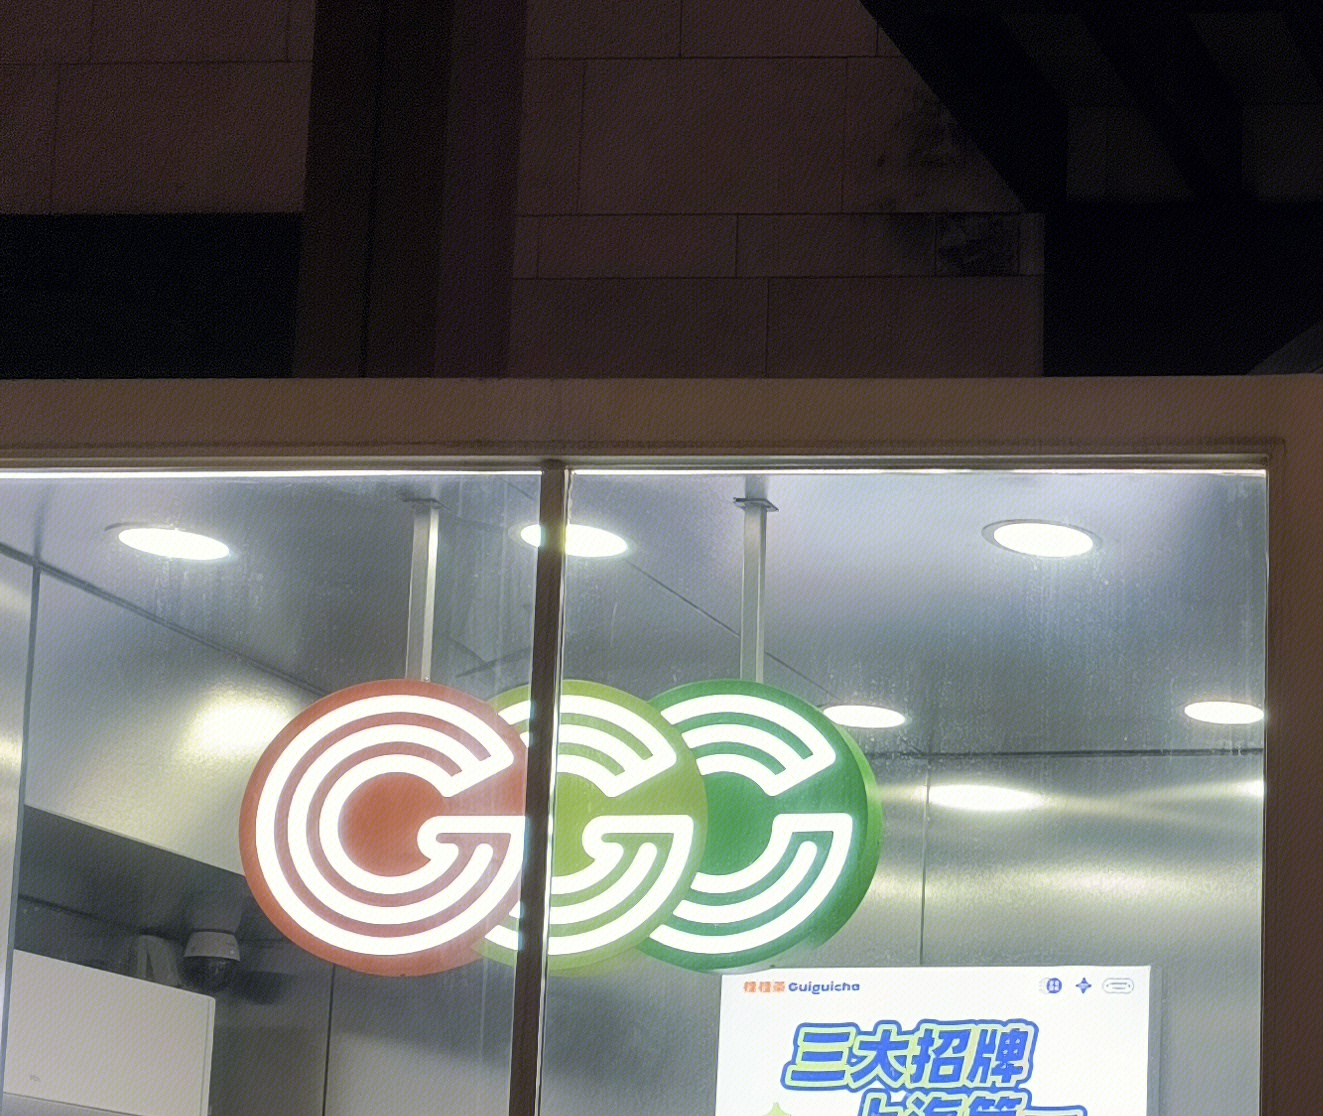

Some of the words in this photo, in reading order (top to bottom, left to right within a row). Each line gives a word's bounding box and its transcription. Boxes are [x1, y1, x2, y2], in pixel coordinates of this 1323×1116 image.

[788, 980, 860, 995] Guiguicha
[787, 1026, 1032, 1087] 三大招牌
